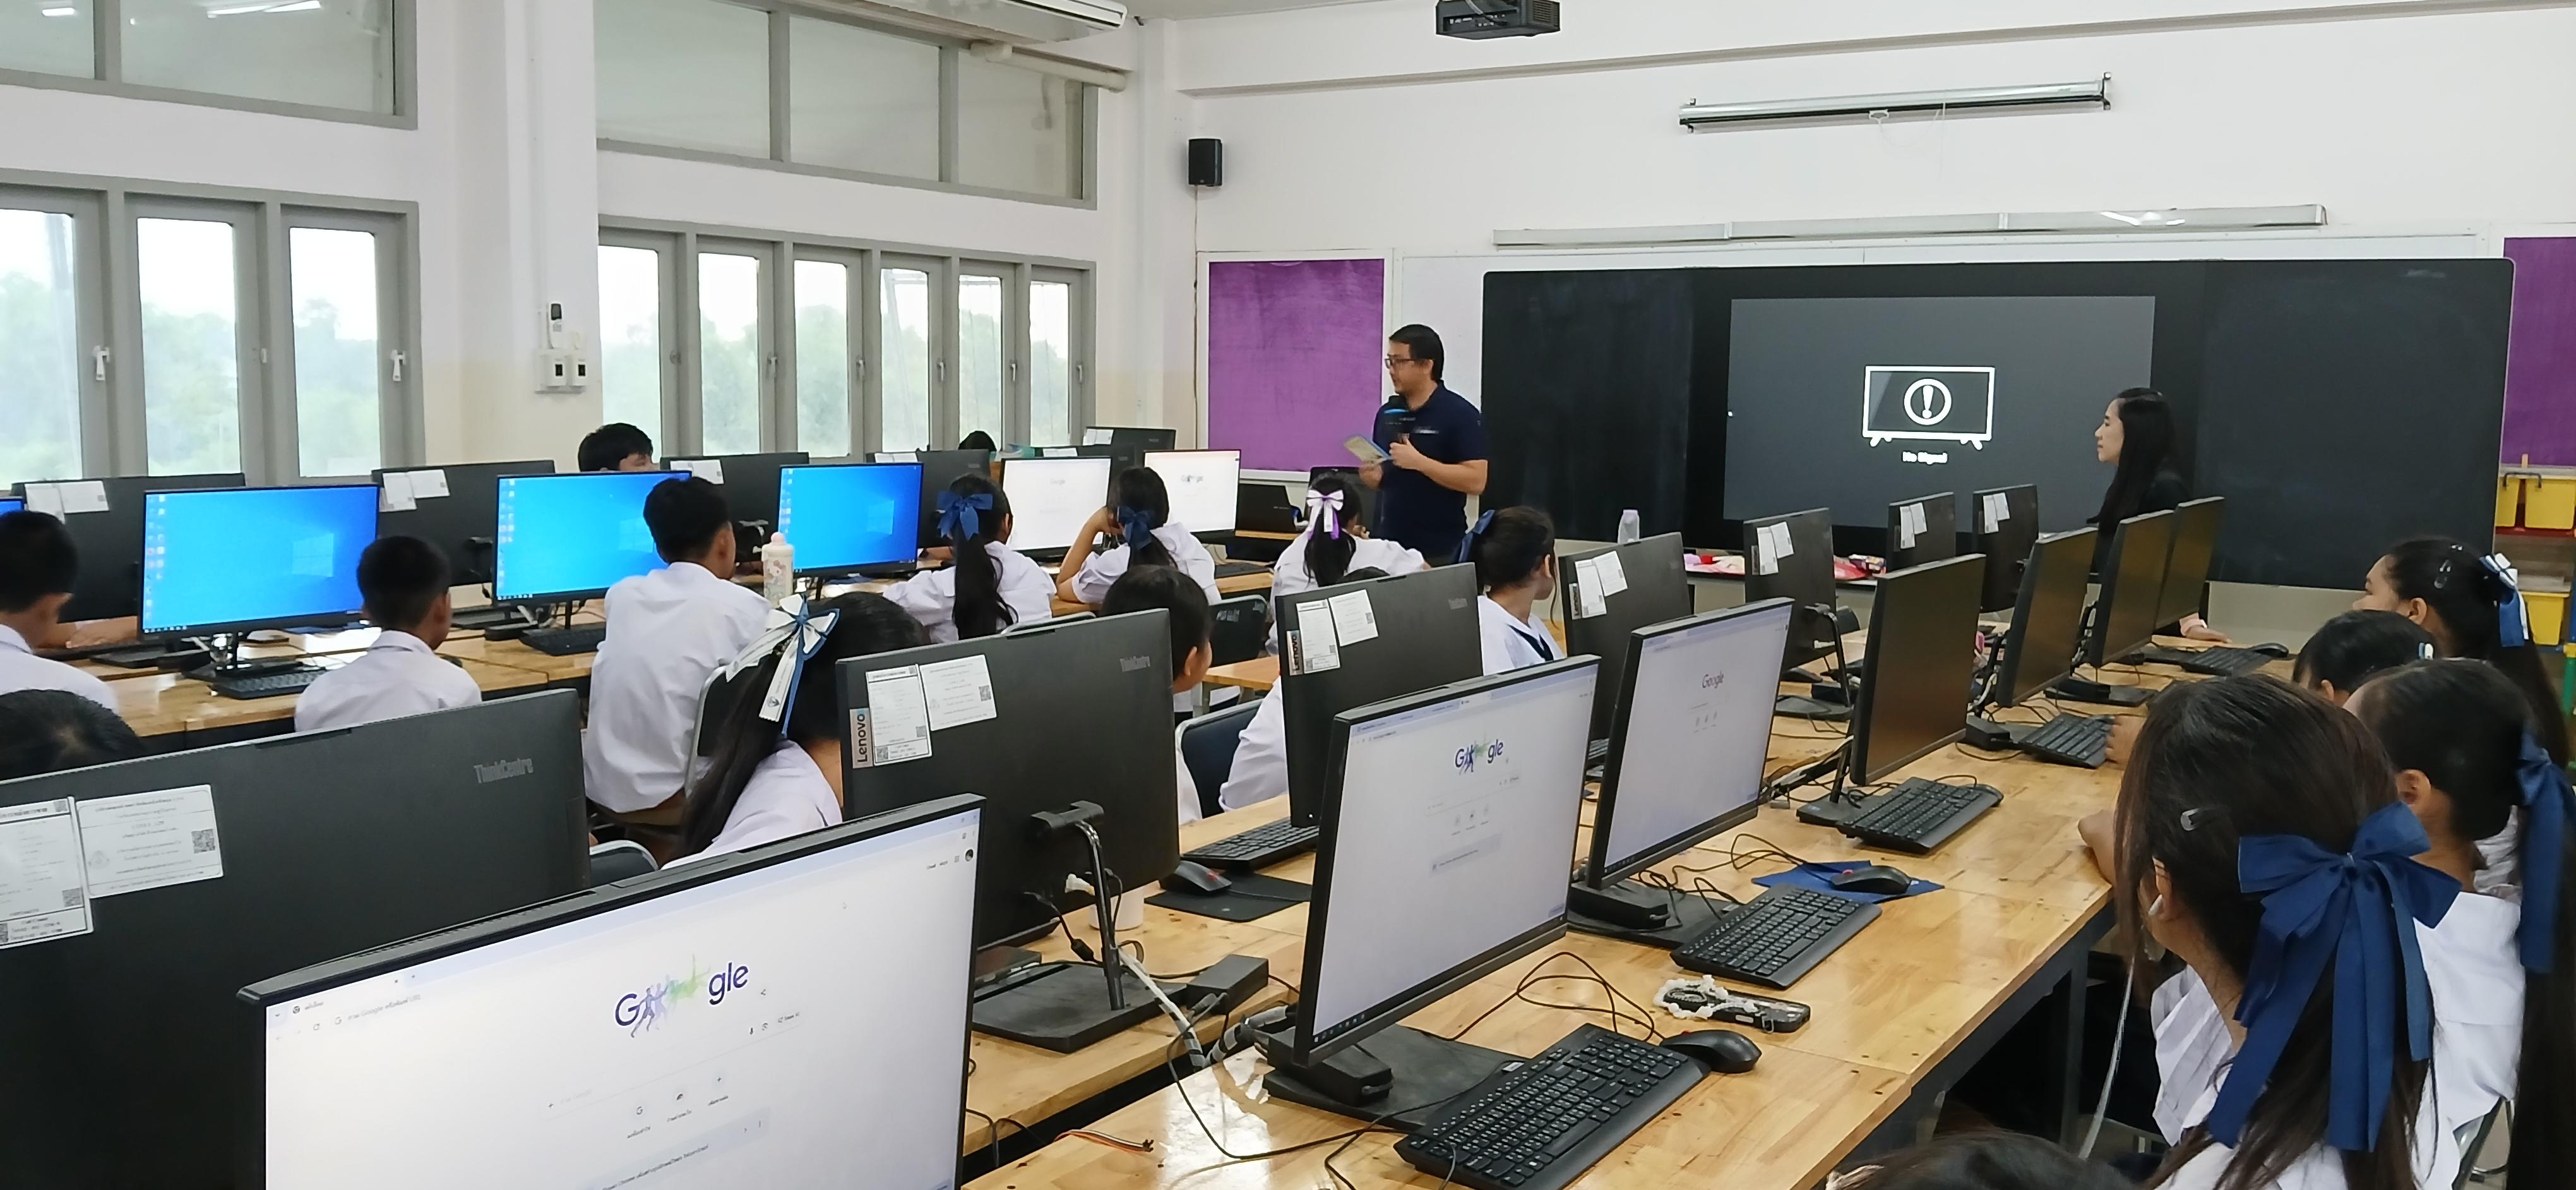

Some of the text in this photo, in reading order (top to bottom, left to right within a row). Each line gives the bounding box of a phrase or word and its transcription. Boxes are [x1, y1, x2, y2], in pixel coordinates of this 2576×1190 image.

[1902, 451, 1948, 465] No Signal
[1702, 670, 1724, 689] Google
[857, 713, 868, 763] Lenovo
[474, 757, 534, 784] ThinkCentre
